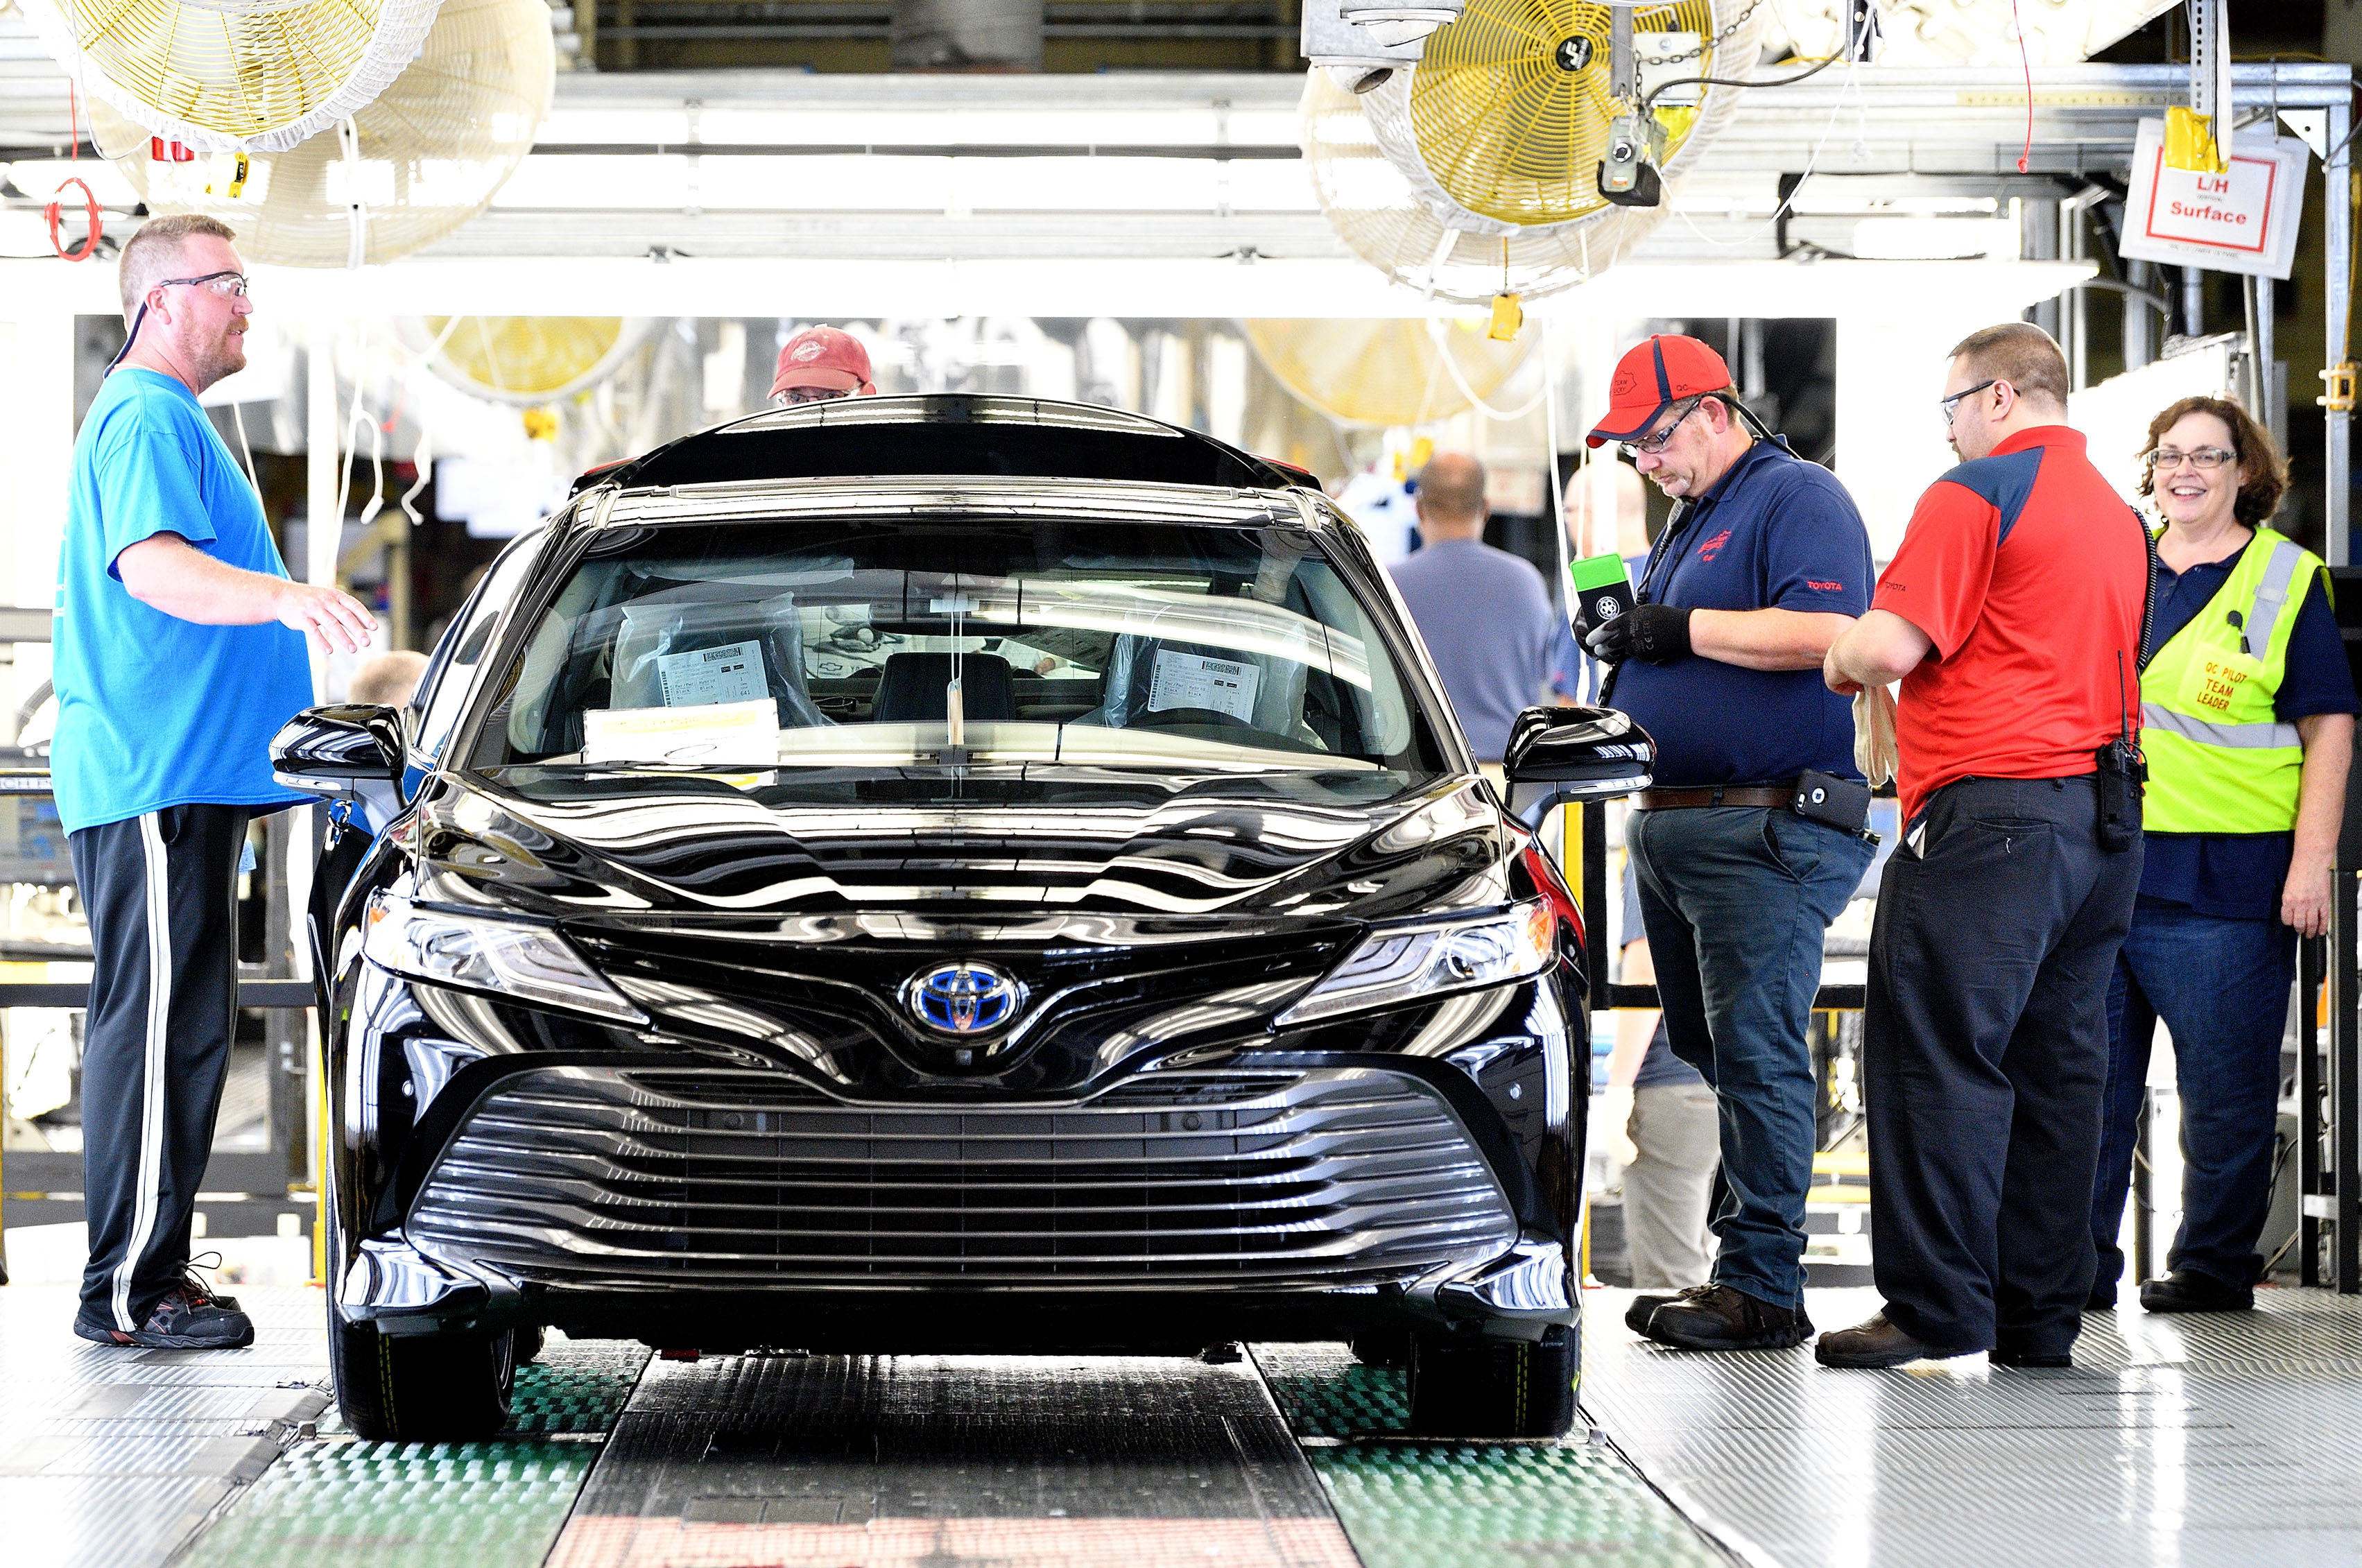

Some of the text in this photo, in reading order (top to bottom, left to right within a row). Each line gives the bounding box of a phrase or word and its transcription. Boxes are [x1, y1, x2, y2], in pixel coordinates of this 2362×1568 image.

[2197, 176, 2229, 193] L/H
[2171, 200, 2246, 225] Surface
[1807, 581, 1843, 591] TOYOTA
[1884, 581, 1907, 592] OYOTA
[2205, 662, 2248, 683] QC PILOT
[2206, 679, 2234, 698] TEAM
[2196, 691, 2230, 712] LEADER
